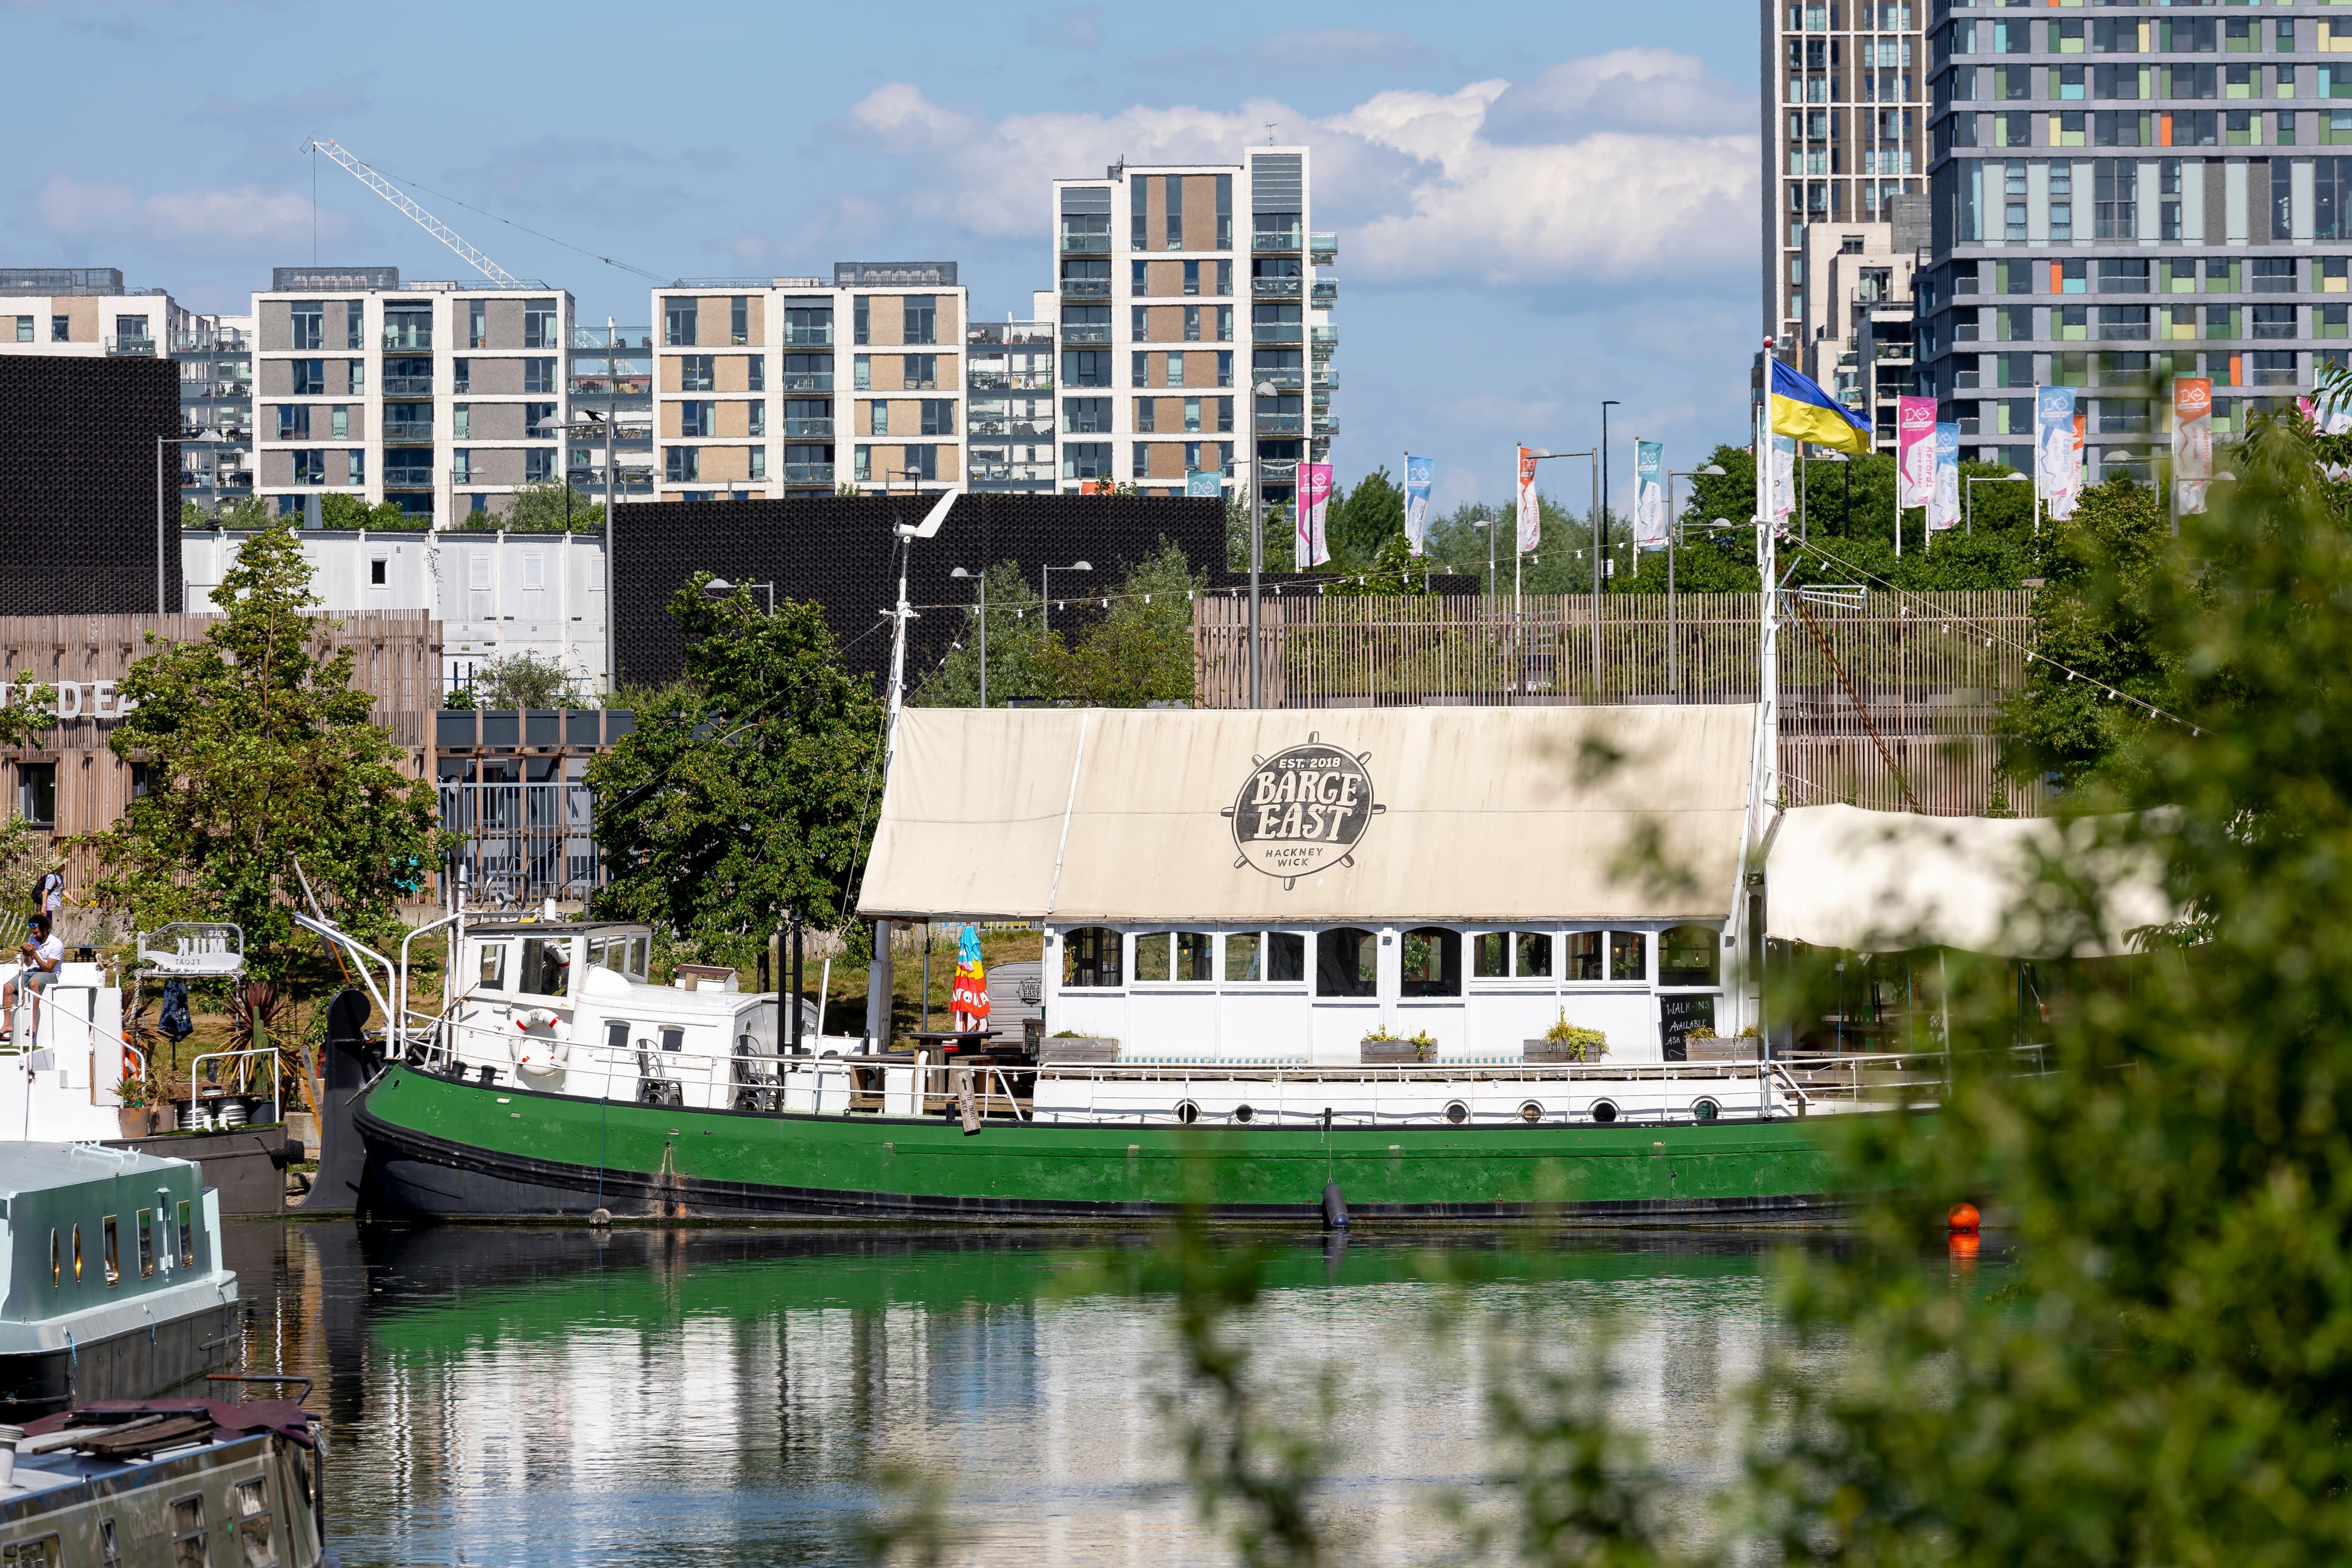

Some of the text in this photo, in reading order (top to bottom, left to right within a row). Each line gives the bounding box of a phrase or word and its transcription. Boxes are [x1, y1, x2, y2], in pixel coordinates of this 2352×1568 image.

[1926, 447, 1934, 488] Records
[2063, 439, 2071, 473] Legacy
[1278, 757, 1341, 769] EST. 2018
[1251, 770, 1362, 806] BARGE
[1254, 802, 1353, 841] EAST
[1265, 848, 1323, 858] HACKNEY
[1277, 858, 1309, 867] WICK
[1665, 1036, 1681, 1045] ASK
